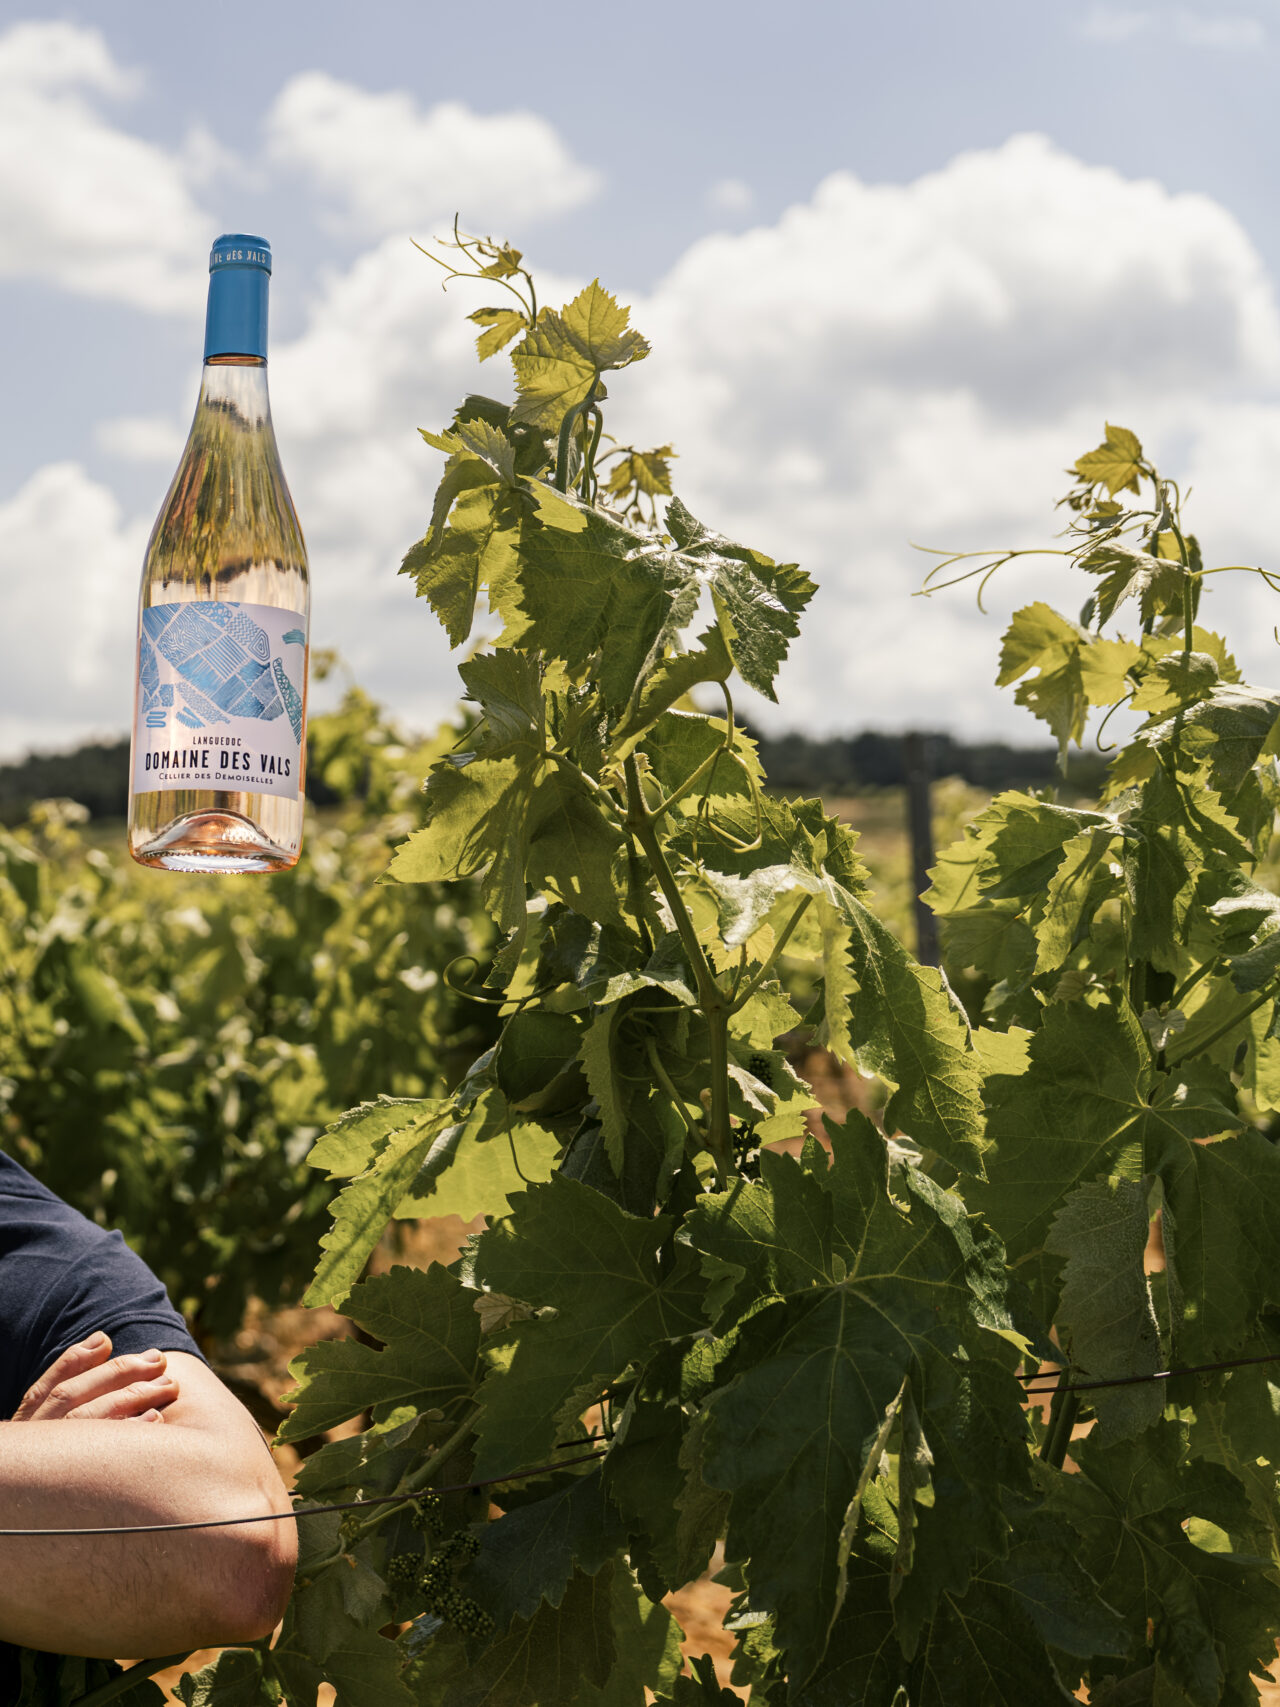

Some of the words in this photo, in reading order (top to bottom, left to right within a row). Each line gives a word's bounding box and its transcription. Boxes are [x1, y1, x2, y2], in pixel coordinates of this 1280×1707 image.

[227, 250, 242, 261] DES
[247, 250, 266, 264] VALS
[193, 736, 242, 746] LANGUEDOC
[145, 750, 210, 771] DOMAINE
[220, 750, 251, 770] DES
[260, 754, 291, 777] VALS
